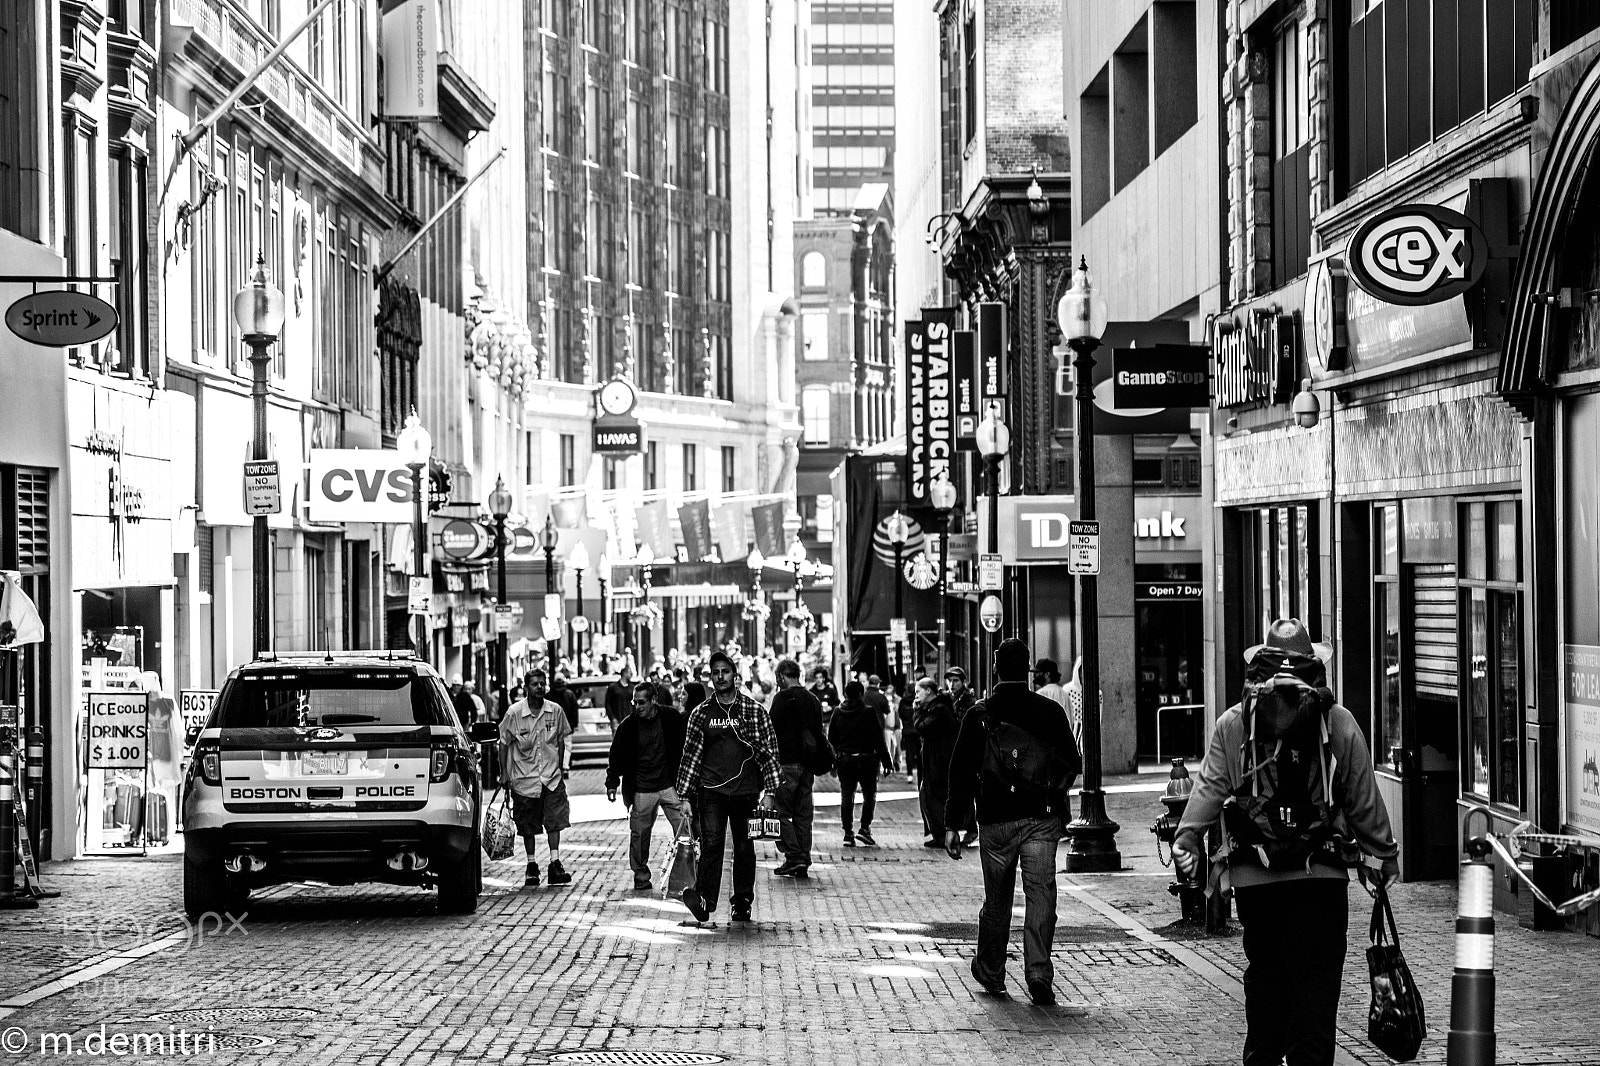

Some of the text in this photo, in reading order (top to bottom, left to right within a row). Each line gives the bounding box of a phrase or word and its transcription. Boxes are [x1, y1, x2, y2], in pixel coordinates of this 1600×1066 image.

[23, 309, 78, 331] Sprint
[1118, 370, 1205, 386] GameStop
[928, 322, 949, 492] STARBUCK
[597, 433, 637, 445] HAVAS
[246, 464, 277, 474] TOW ZONE
[255, 477, 269, 485] NO
[321, 468, 413, 503] CVS
[1020, 512, 1071, 548] TD
[1072, 524, 1098, 534] TOW ZONE
[1149, 586, 1174, 597] Open
[1177, 586, 1182, 595] 7
[1571, 672, 1586, 699] FOR
[92, 703, 147, 716] ICE COLD
[91, 725, 147, 738] DRINKS
[107, 746, 140, 760] 1.00
[230, 786, 415, 799] BOSTON POLICE
